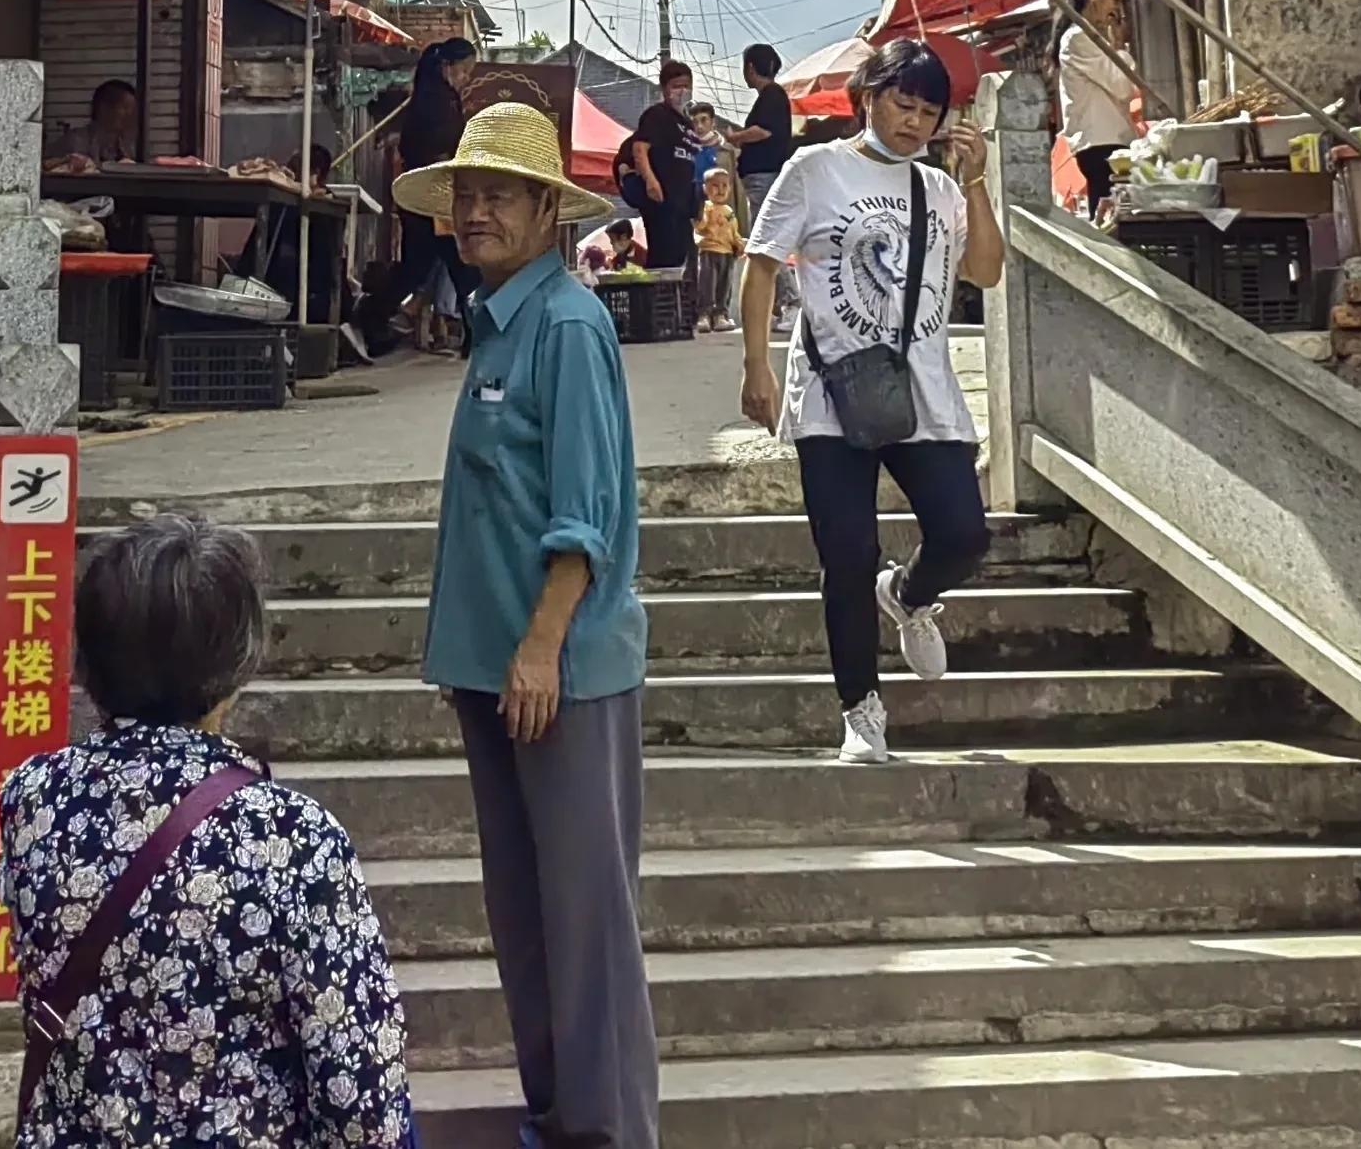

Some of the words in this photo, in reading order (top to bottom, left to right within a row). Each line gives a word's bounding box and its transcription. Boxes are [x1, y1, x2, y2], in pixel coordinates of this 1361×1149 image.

[829, 213, 855, 248] ALL
[827, 250, 844, 300] BALL
[834, 297, 885, 344] SAME
[890, 327, 923, 345] TE
[0, 539, 58, 739] 上下楼梯
